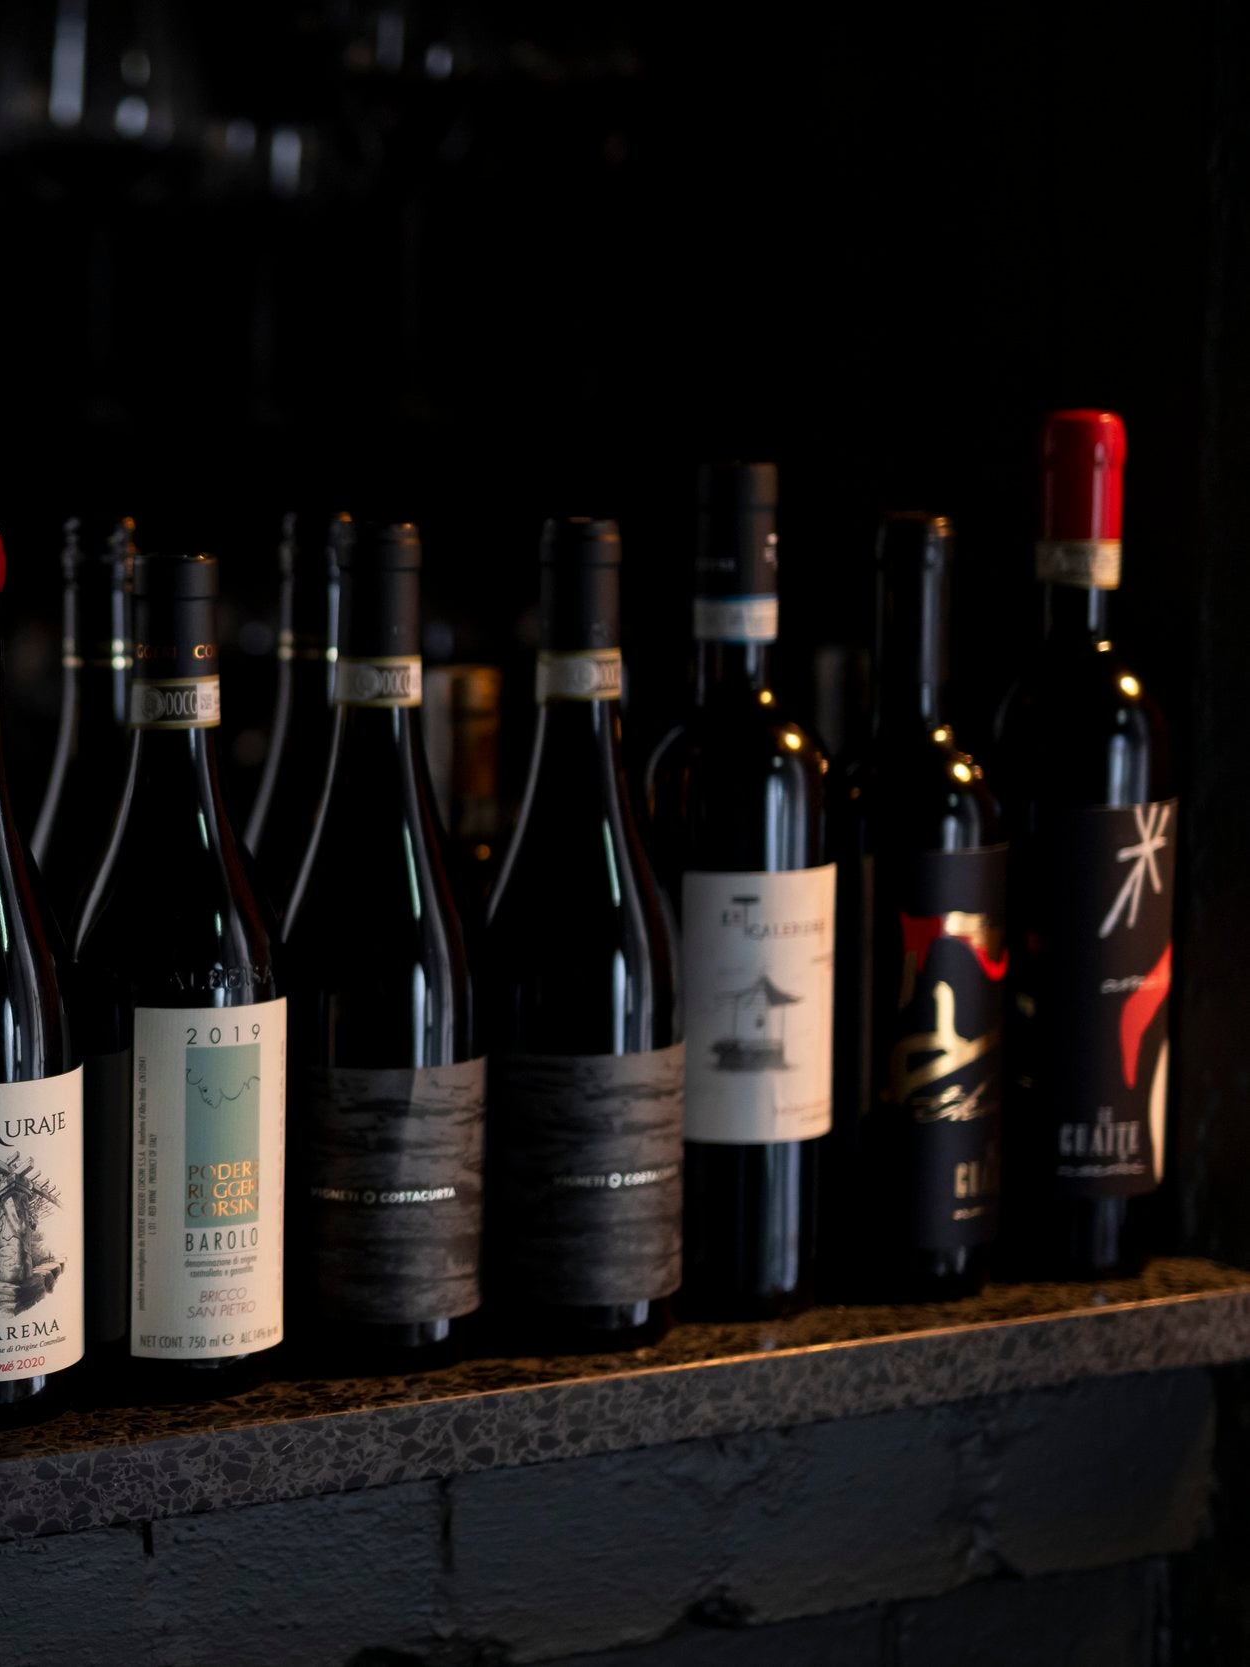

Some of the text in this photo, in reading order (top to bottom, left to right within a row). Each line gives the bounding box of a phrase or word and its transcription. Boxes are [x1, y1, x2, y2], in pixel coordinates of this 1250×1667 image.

[186, 1023, 261, 1045] 2019
[379, 1186, 457, 1204] COSTACURTA
[185, 1227, 259, 1251] BAROLO
[199, 1286, 248, 1302] BRICCO
[187, 1301, 257, 1319] SAN PIETRO
[15, 1343, 38, 1352] Origine
[140, 1335, 157, 1347] NET
[189, 1336, 207, 1349] 750
[17, 1355, 45, 1370] 2020
